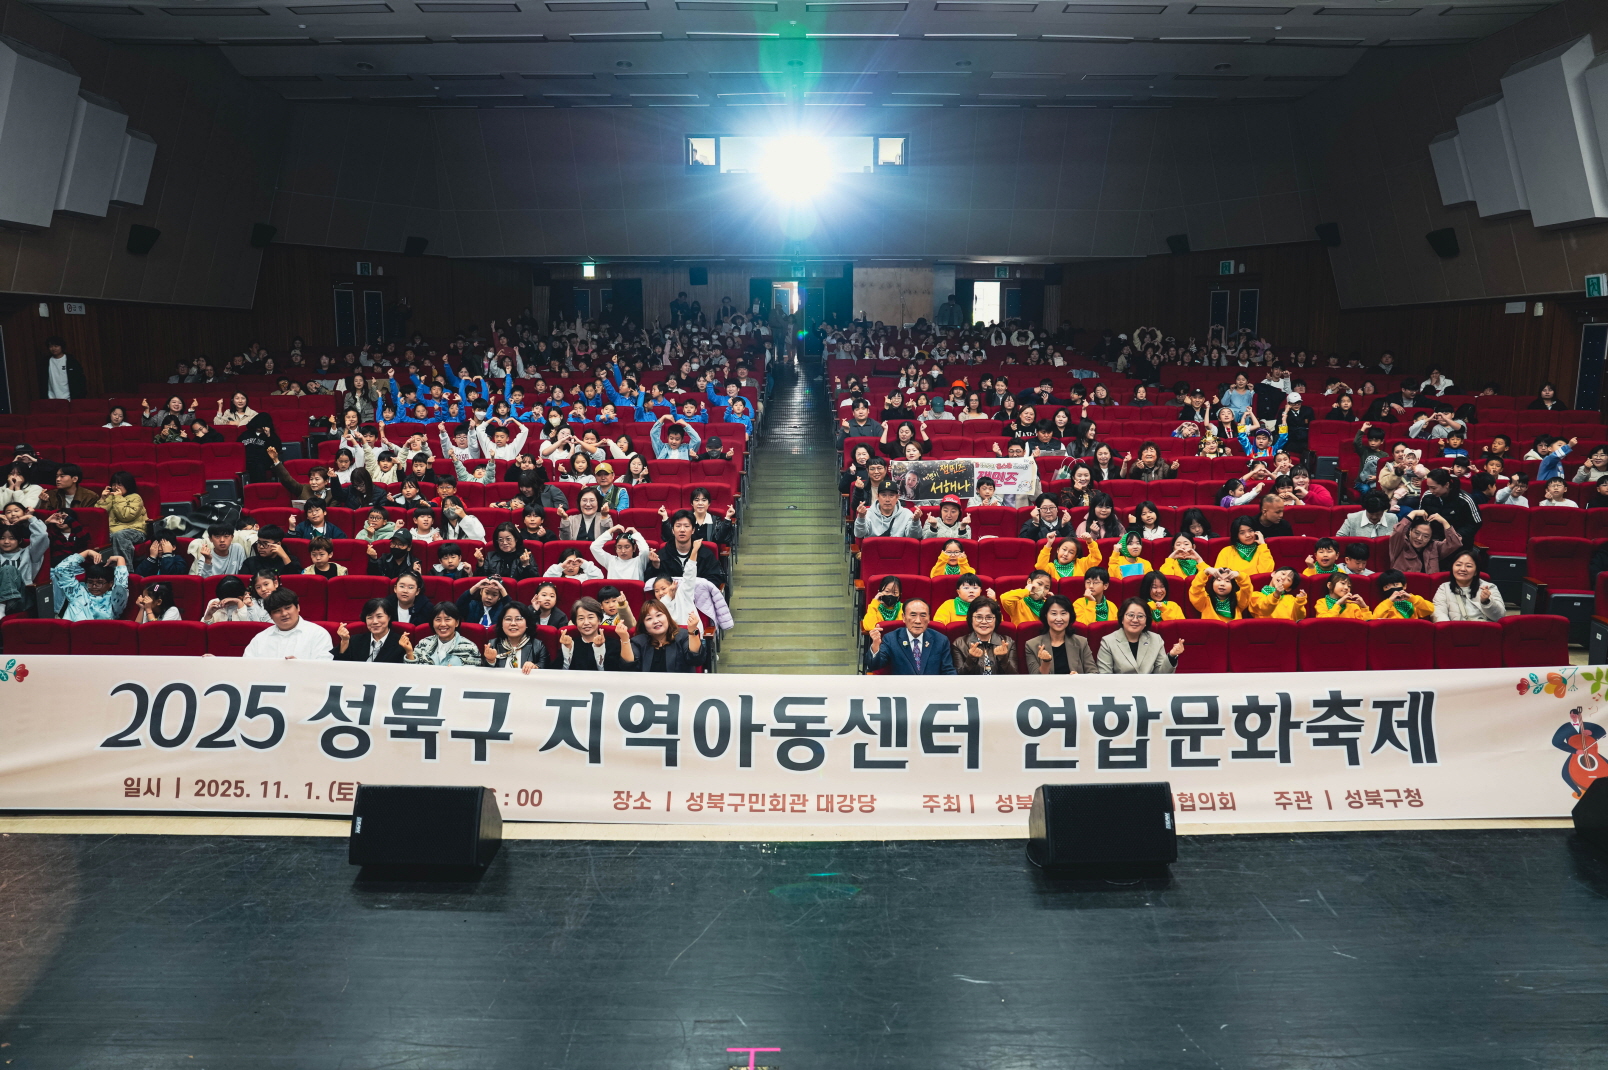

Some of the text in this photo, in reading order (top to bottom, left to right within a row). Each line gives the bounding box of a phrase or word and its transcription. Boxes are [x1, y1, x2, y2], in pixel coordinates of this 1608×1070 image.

[885, 481, 892, 489] P
[930, 479, 971, 494] 서해나
[100, 682, 1439, 772] 2025 성북구 지역아동센터 연합문화축제
[123, 776, 162, 799] 일시
[193, 778, 251, 798] 2025.
[260, 780, 289, 799] 11.
[328, 780, 362, 803] (토
[1273, 787, 1424, 811] 주관 성북구청
[612, 790, 877, 814] 장소 성북구민회관 대강당
[922, 791, 1237, 814] 주최 성북 협의회
